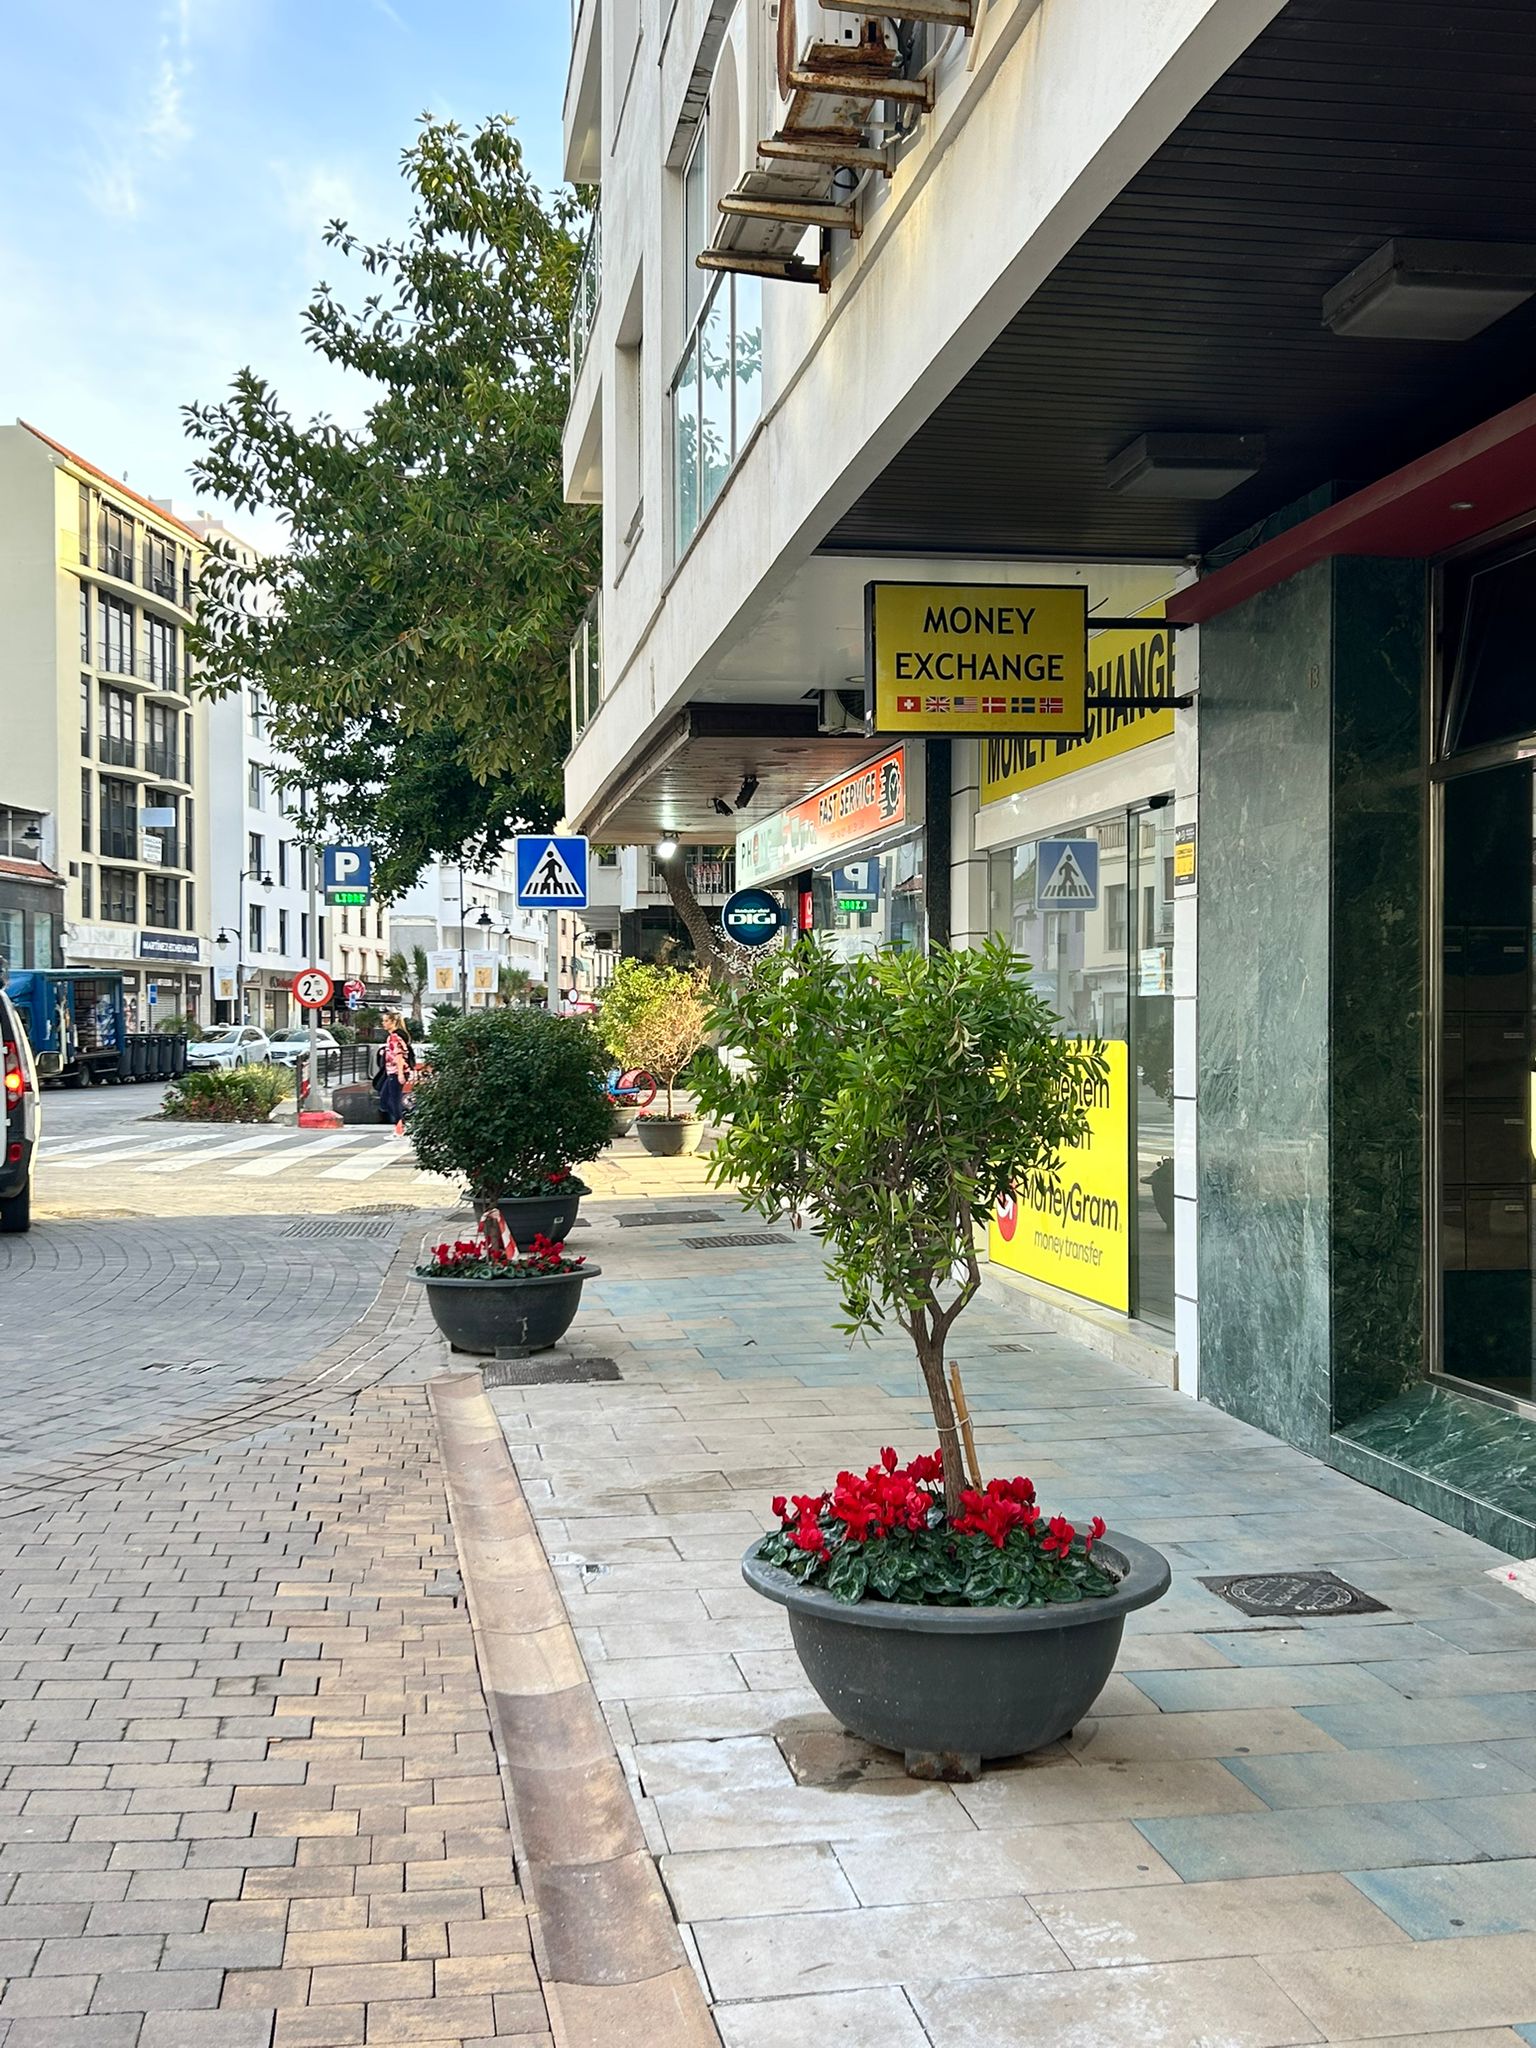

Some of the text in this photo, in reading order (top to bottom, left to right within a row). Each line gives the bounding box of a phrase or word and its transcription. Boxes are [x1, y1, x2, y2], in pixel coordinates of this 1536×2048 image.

[923, 606, 1036, 635] MONEY
[895, 652, 1065, 682] EXCHANGE
[818, 771, 877, 826] FAST SERVICE
[335, 851, 360, 882] P
[728, 913, 777, 925] DIGI
[1022, 1173, 1119, 1231] MoneyGram
[1034, 1230, 1103, 1267] money transfer
